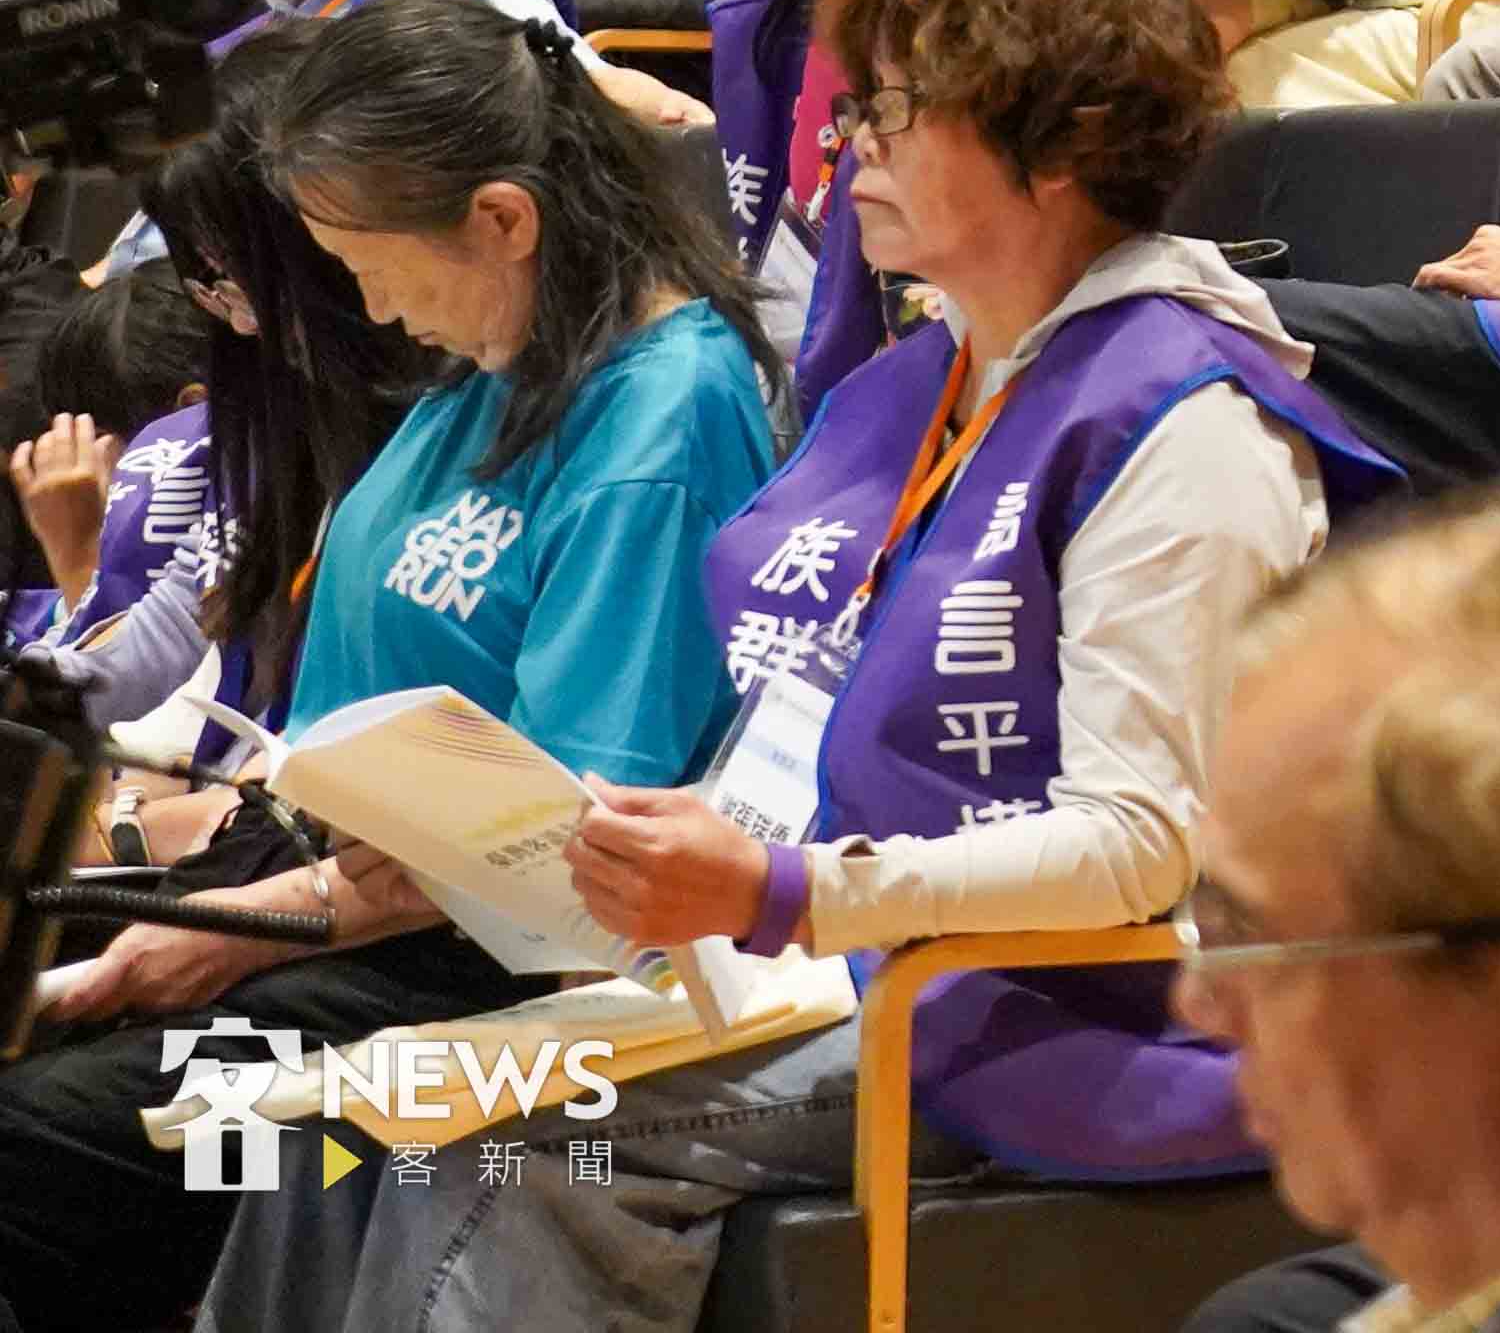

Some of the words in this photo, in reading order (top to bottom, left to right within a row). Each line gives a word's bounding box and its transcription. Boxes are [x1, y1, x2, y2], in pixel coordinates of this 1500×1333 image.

[383, 548, 487, 623] RUN
[404, 518, 498, 580] GEO
[727, 516, 858, 695] 族群
